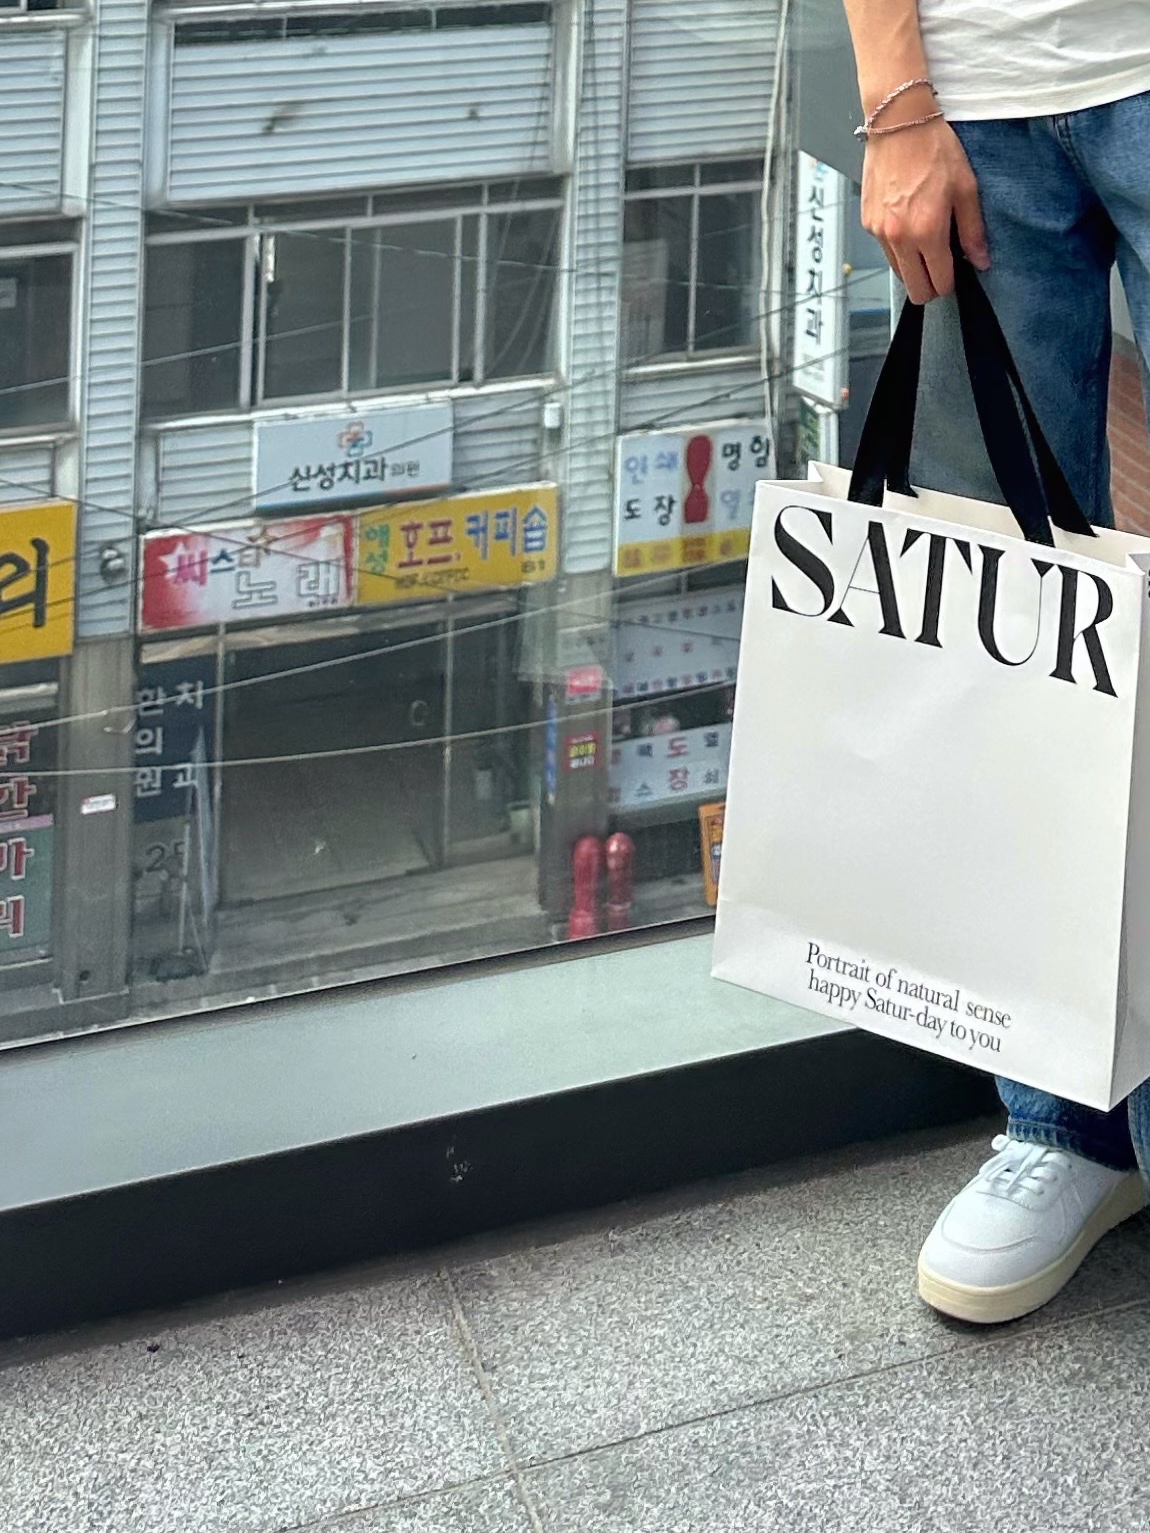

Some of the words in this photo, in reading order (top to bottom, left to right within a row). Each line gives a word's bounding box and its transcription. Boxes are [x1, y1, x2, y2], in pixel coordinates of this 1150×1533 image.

[806, 185, 825, 345] 신성치과
[397, 519, 453, 568] 호프
[466, 506, 548, 560] 커피숍
[624, 493, 678, 526] 도장
[231, 558, 343, 610] 노래
[771, 504, 1119, 698] SATUR
[805, 942, 871, 983] Portrait
[875, 968, 898, 990] of
[898, 978, 960, 1012] natural
[965, 1000, 1012, 1029] sense
[807, 969, 862, 1011] happy
[864, 987, 947, 1039] Satur-day
[950, 1021, 967, 1041] to
[968, 1027, 1001, 1053] you
